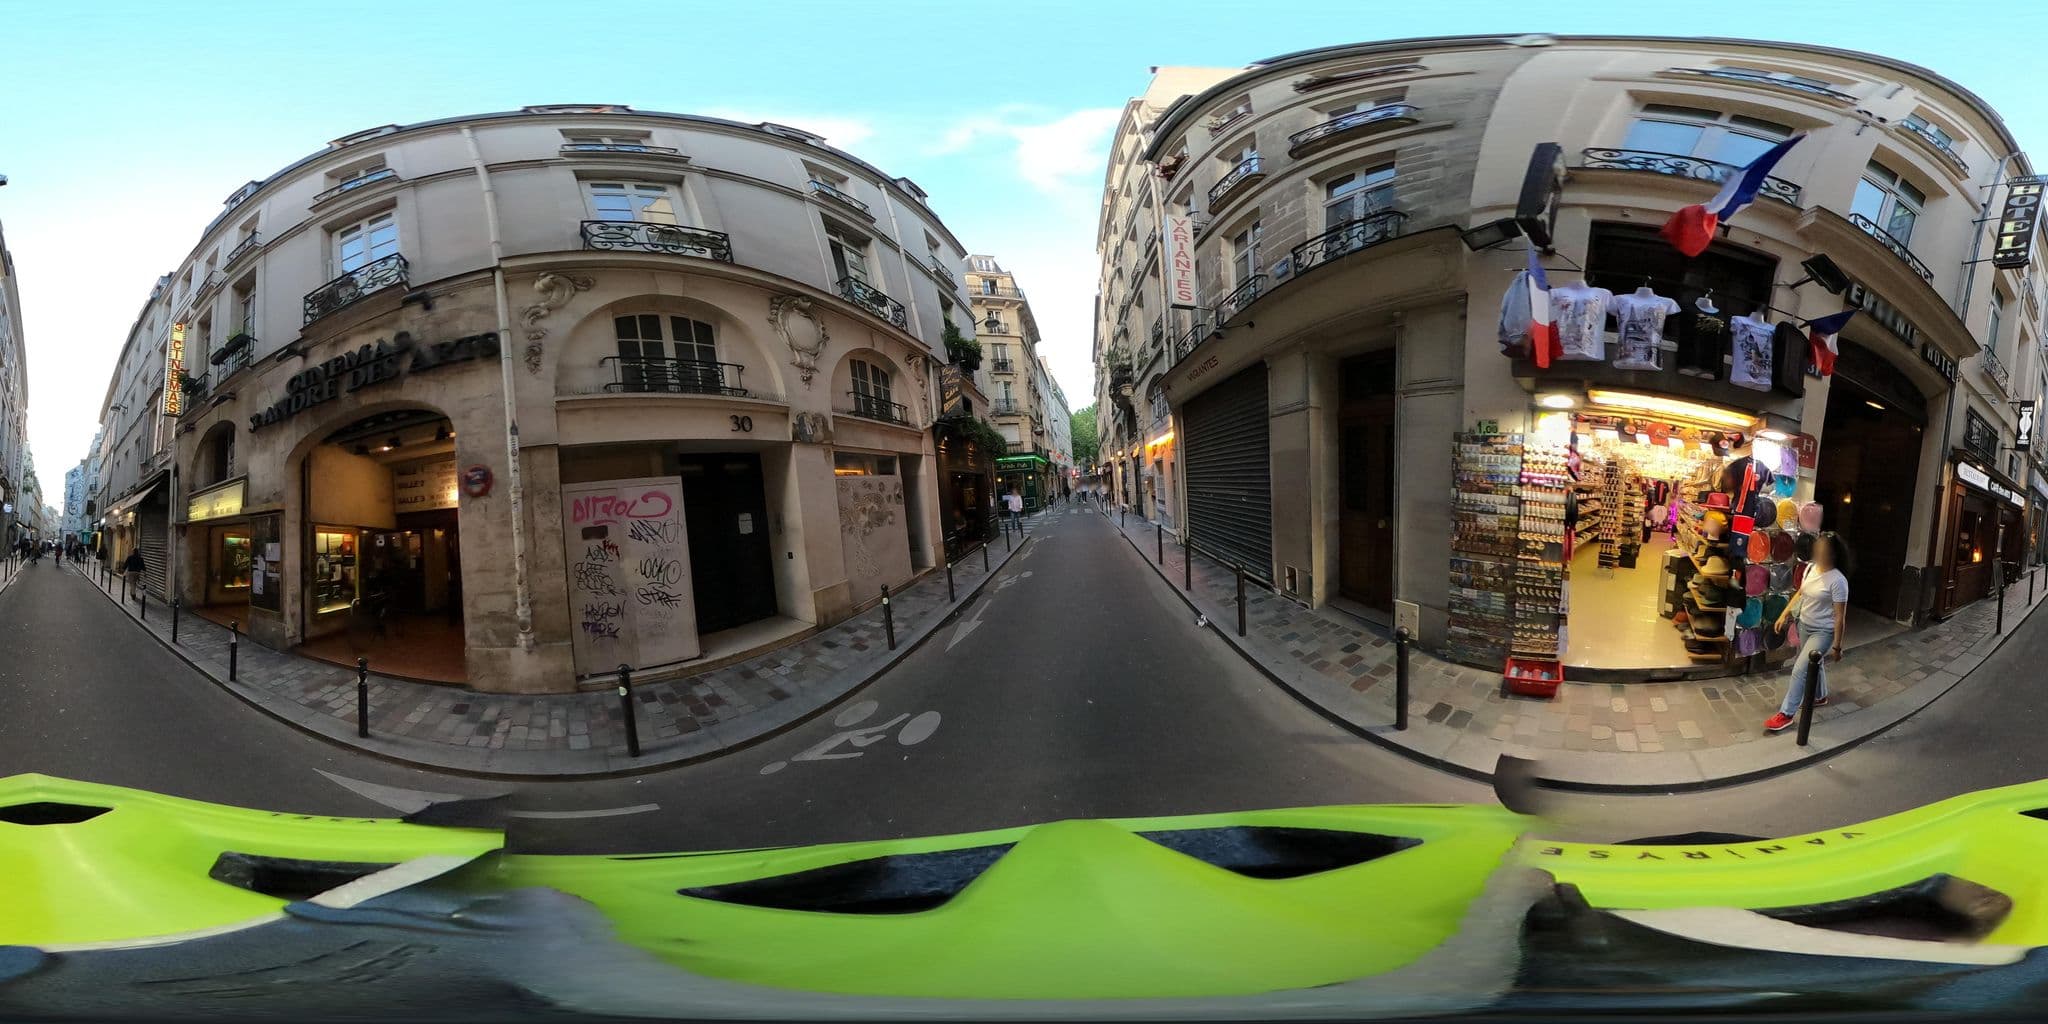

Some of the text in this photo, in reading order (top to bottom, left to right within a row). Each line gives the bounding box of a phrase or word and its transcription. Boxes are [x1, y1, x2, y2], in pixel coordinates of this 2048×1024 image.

[1998, 184, 2041, 251] HOTEL
[1173, 218, 1193, 302] VARIANTES
[168, 322, 184, 414] 3 CINEMAS
[730, 415, 752, 432] 30
[1803, 439, 1814, 452] H
